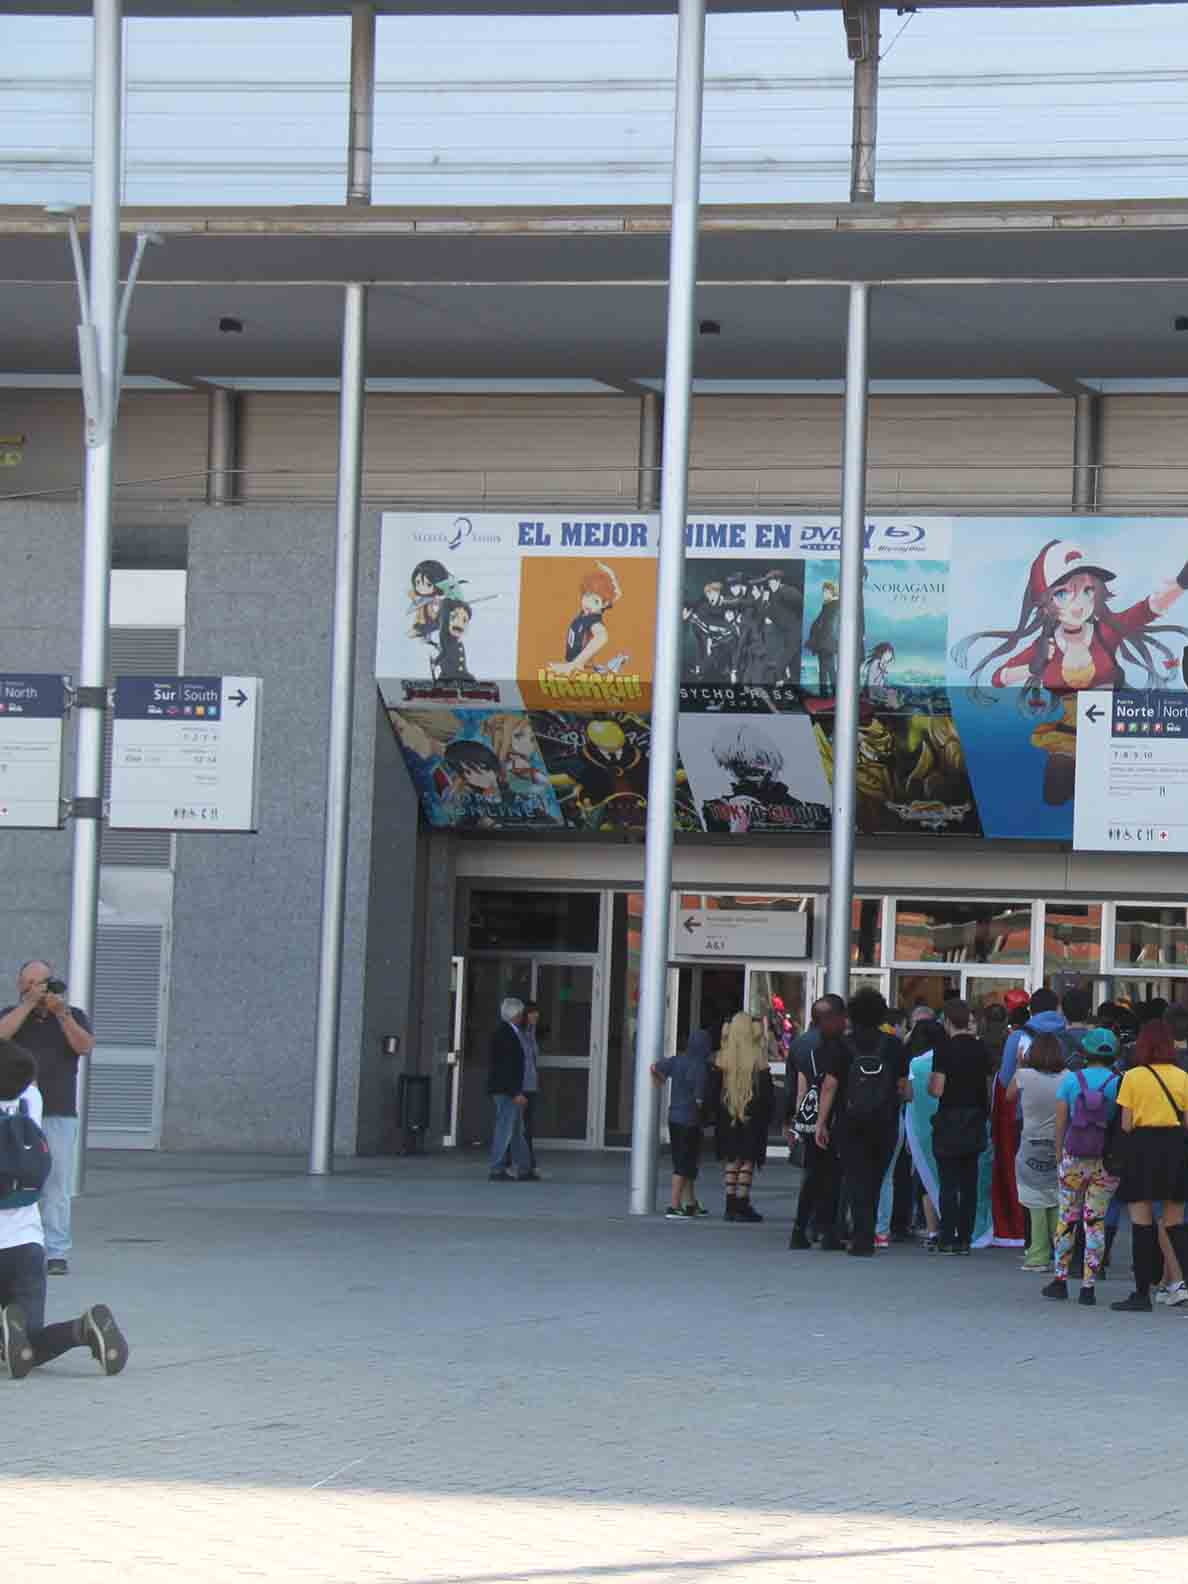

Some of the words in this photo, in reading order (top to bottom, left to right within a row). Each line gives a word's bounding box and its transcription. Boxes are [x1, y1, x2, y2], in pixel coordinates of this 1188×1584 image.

[518, 522, 550, 546] EL
[560, 522, 648, 547] MEJOR
[755, 524, 792, 549] EN
[872, 583, 945, 593] NORAGAMI
[5, 687, 37, 698] North
[154, 689, 176, 701] Sur
[184, 689, 218, 701] South
[1116, 706, 1154, 718] Norte
